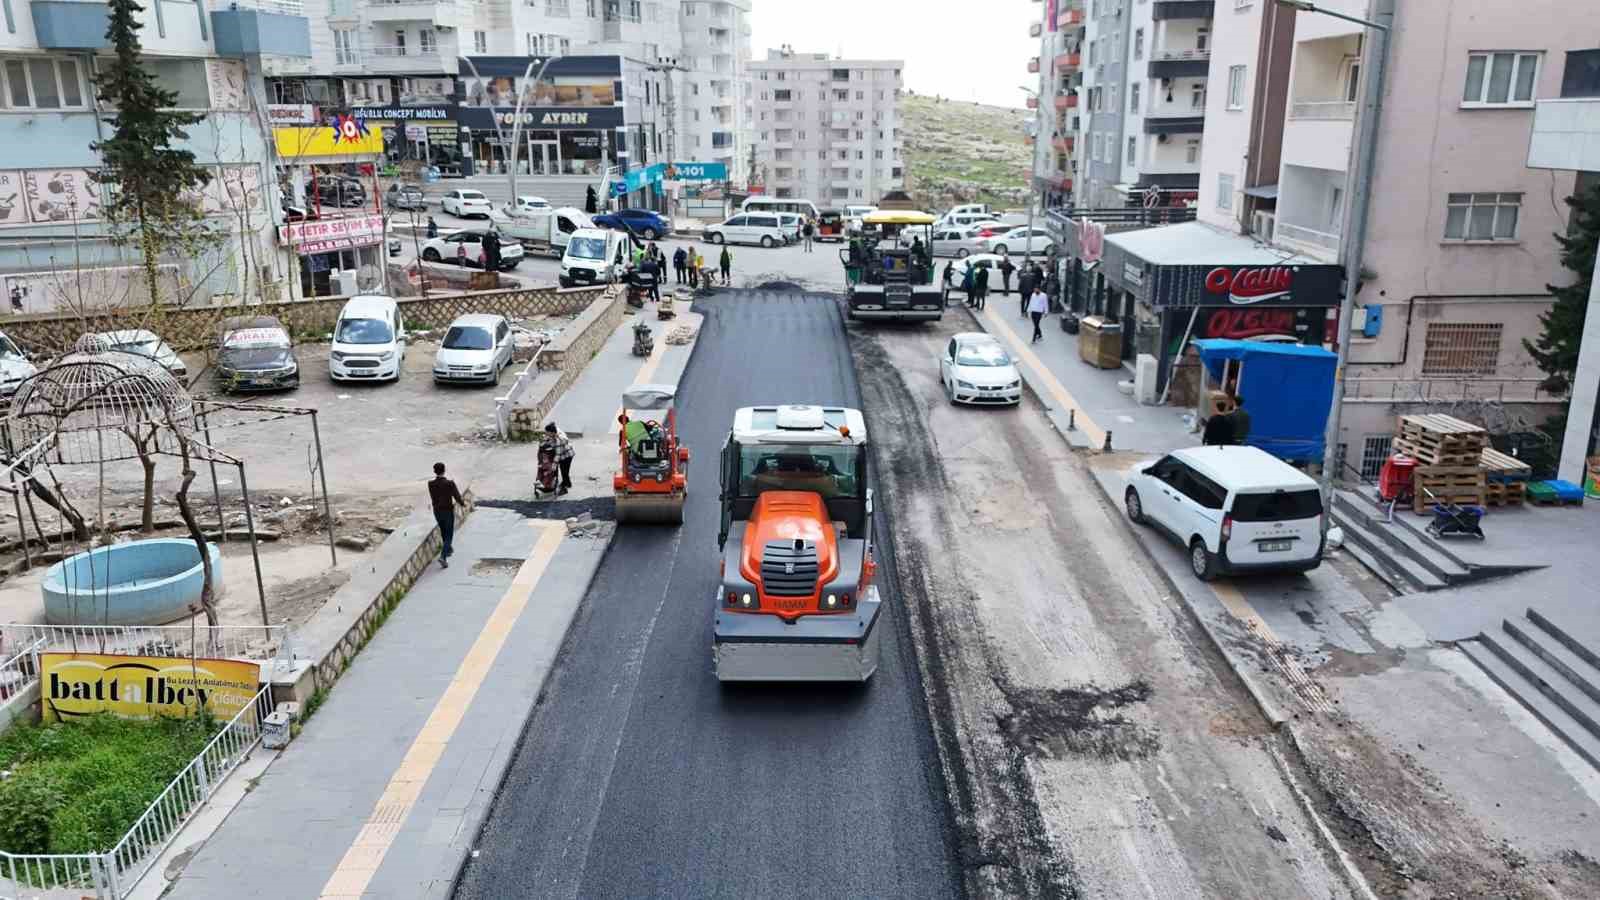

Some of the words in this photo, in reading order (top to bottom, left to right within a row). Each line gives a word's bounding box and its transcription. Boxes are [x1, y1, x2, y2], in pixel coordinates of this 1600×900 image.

[383, 108, 414, 119] CONCEPT
[415, 107, 447, 119] MOBİLYA
[495, 112, 534, 125] FOO
[541, 111, 589, 125] AYDIN
[165, 676, 177, 684] Bu
[50, 672, 213, 707] battalbey
